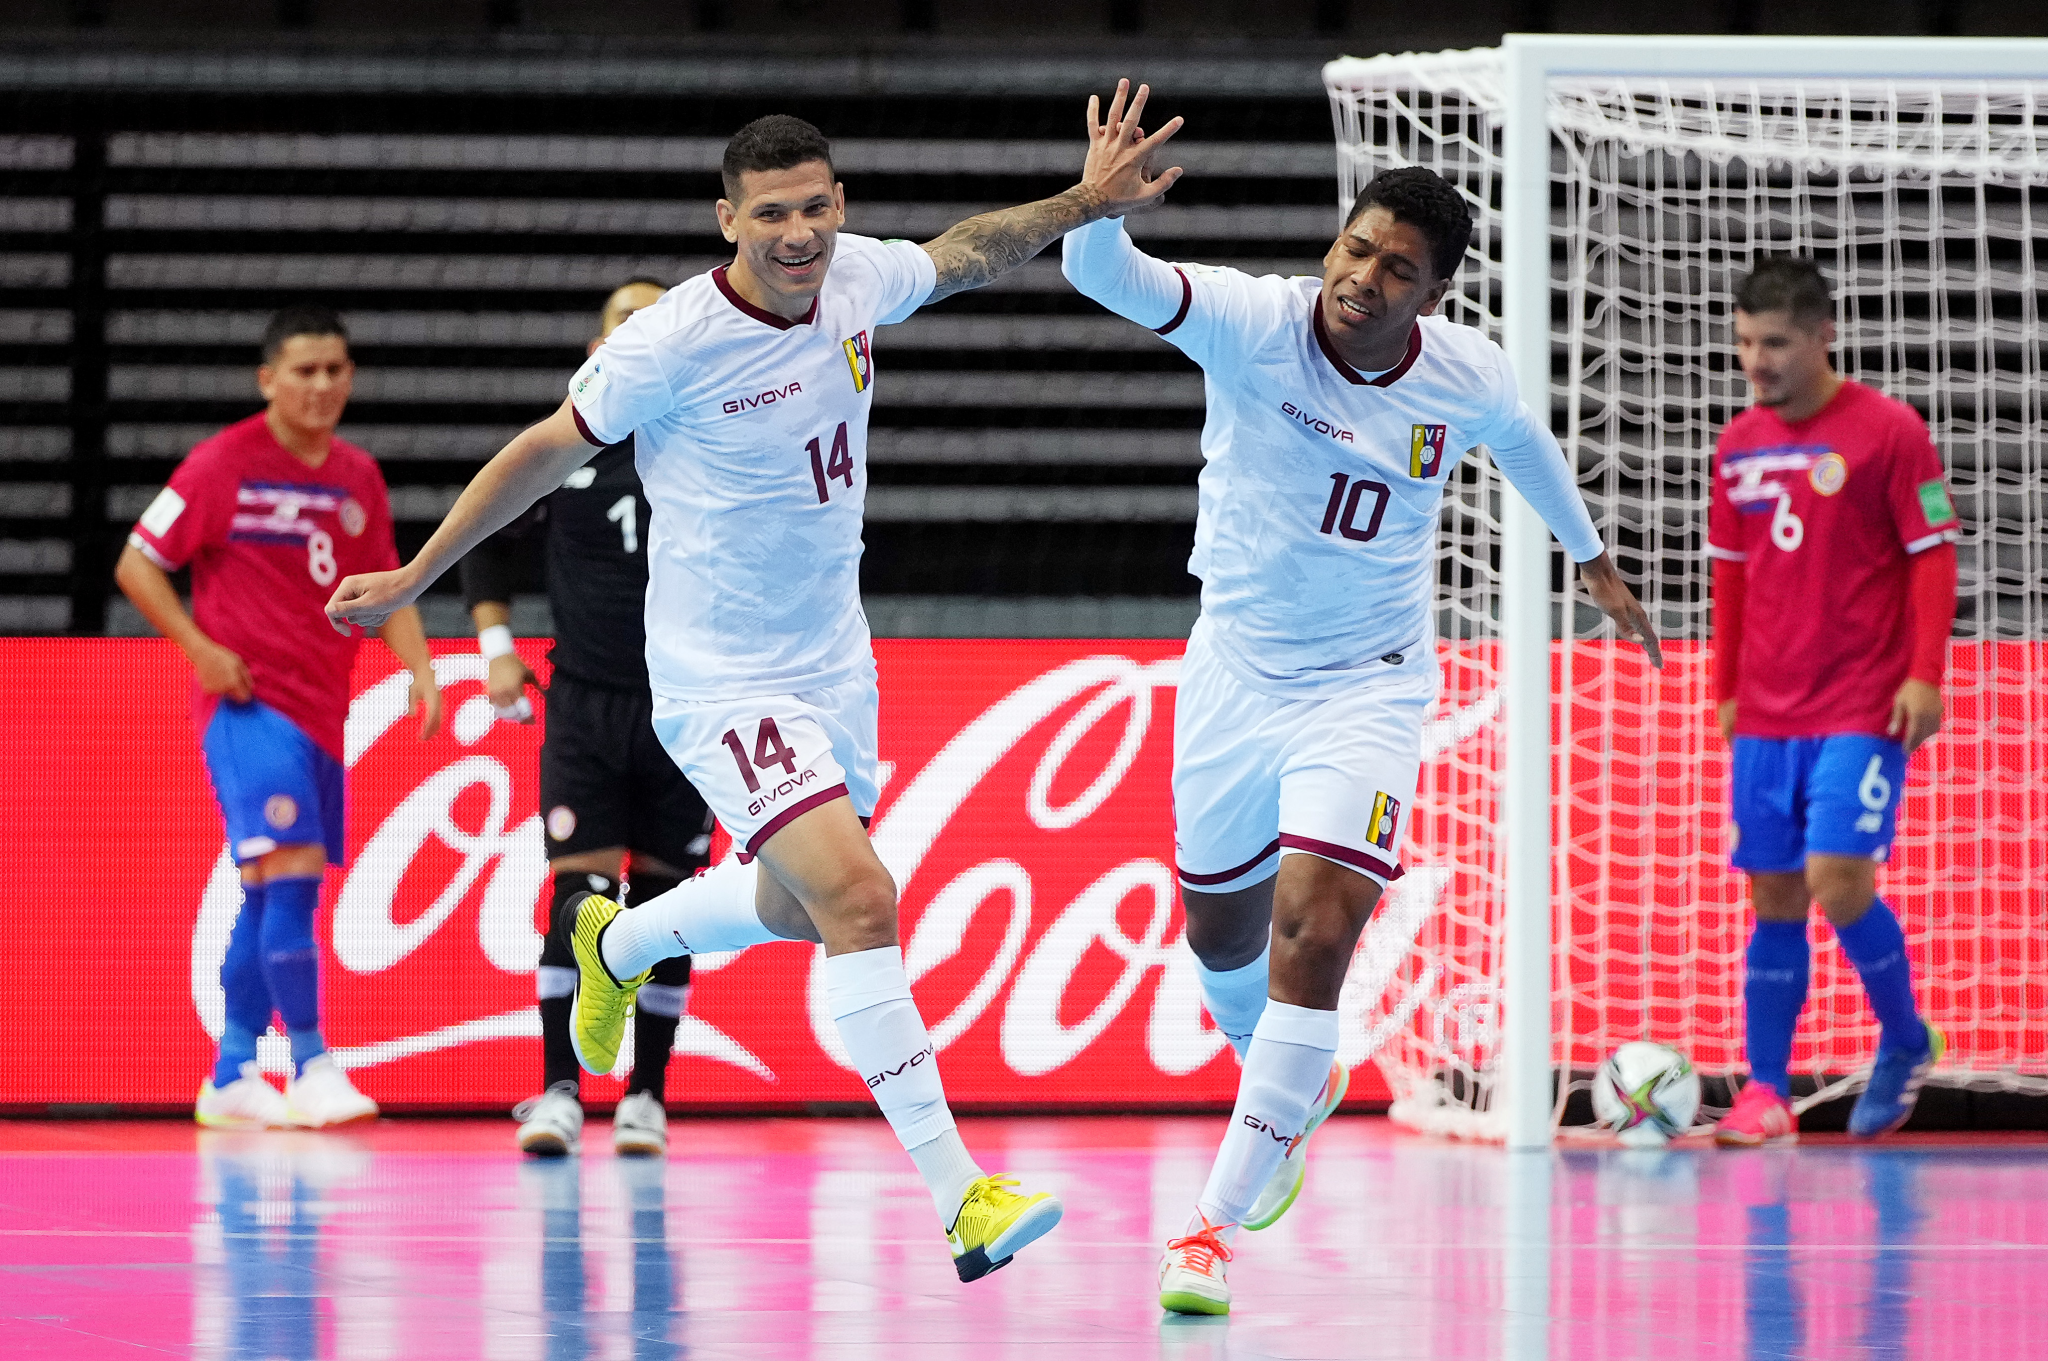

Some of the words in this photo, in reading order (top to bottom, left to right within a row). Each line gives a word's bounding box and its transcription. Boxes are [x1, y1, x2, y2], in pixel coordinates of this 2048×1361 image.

[723, 381, 803, 415] GIVOVA
[1281, 401, 1354, 443] GIVOVA
[804, 421, 855, 505] 14
[1414, 428, 1444, 443] FVF
[607, 495, 638, 553] 1
[1319, 471, 1391, 542] 10
[1770, 493, 1804, 552] 6
[307, 530, 338, 587] 8
[721, 716, 797, 794] 14
[1857, 755, 1892, 811] 6
[747, 769, 818, 817] GIVOVA
[866, 1042, 934, 1089] GIVOV
